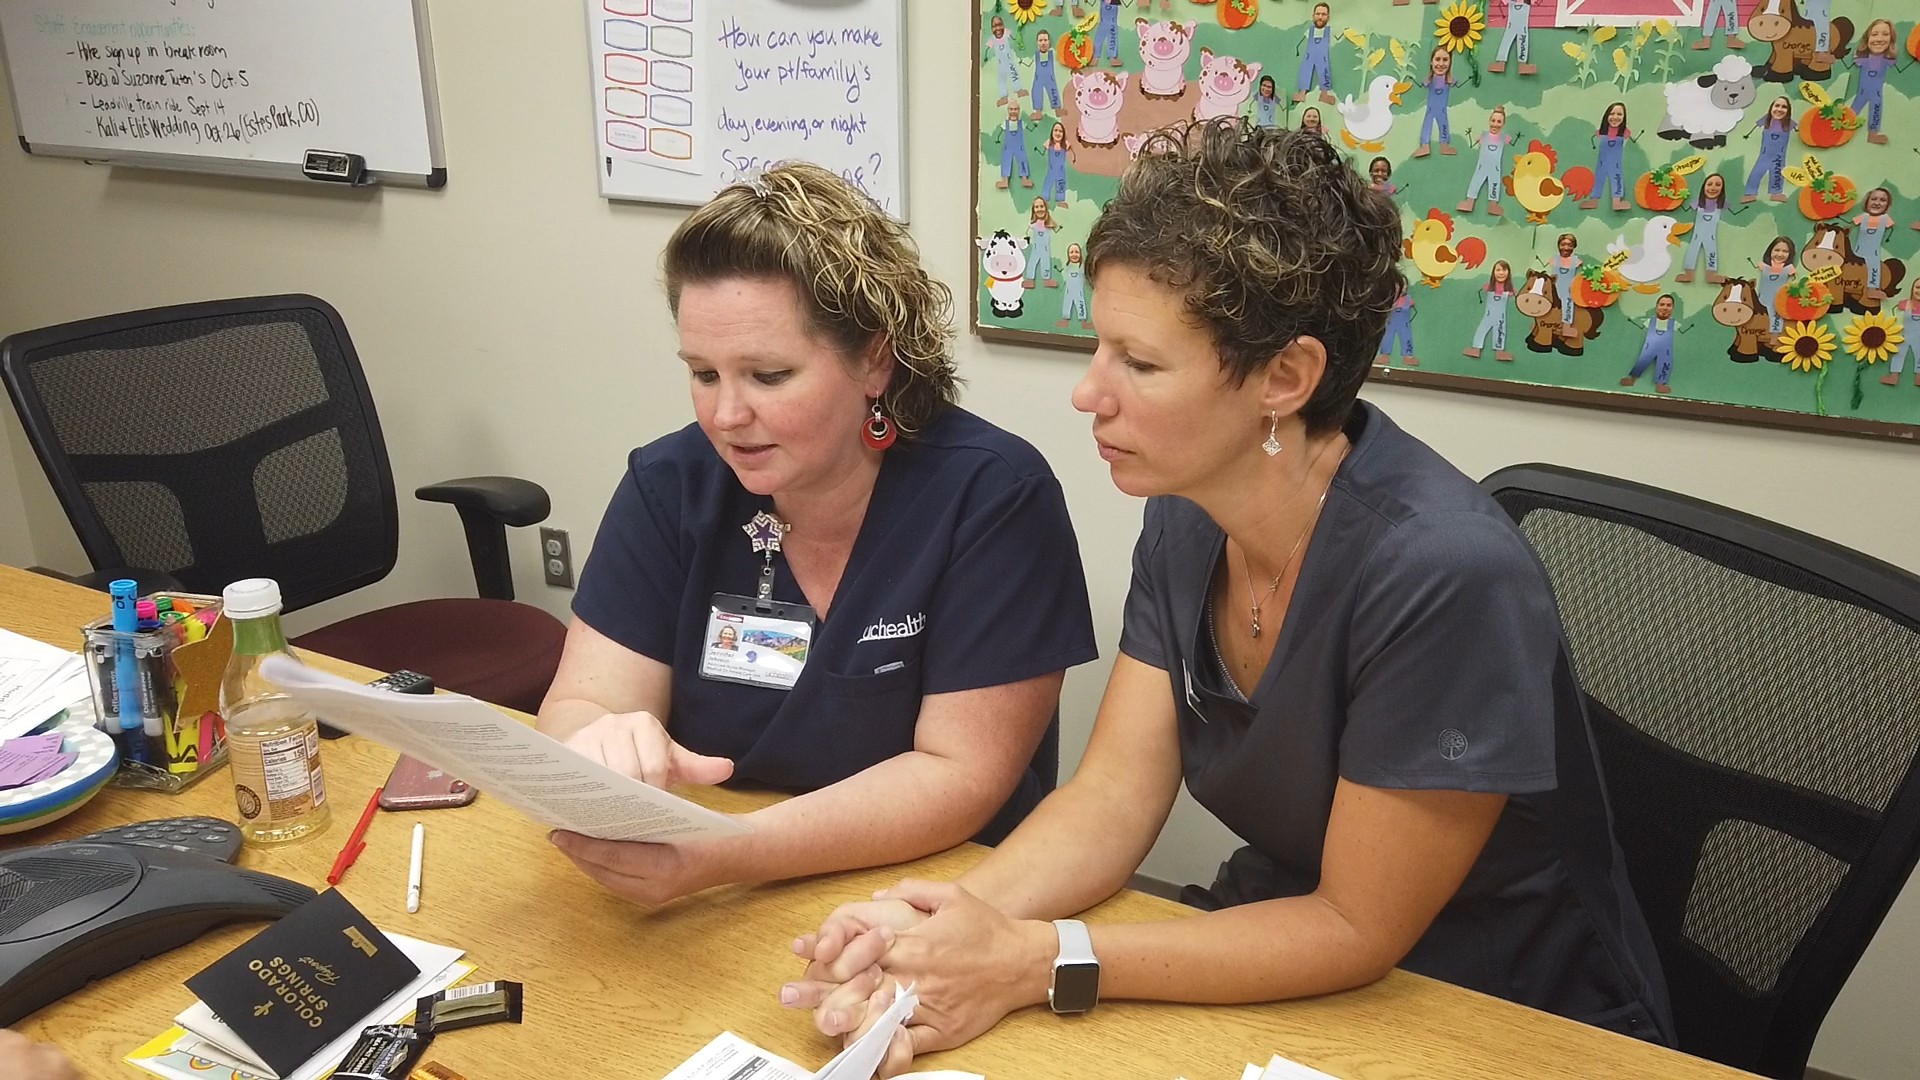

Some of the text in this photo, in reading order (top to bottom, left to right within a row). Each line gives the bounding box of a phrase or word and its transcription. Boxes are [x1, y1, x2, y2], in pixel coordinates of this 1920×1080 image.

[718, 15, 882, 58] How can you make
[1782, 40, 1812, 55] Charge
[147, 46, 158, 57] in
[86, 70, 109, 87] BBQ
[238, 70, 250, 87] 5
[136, 93, 160, 109] train
[164, 98, 182, 112] ride
[187, 96, 211, 117] Sept
[214, 99, 225, 115] 14
[149, 115, 200, 144] Wedding
[831, 111, 867, 145] night
[1835, 276, 1863, 290] Charge
[860, 611, 926, 642] uchealth
[264, 756, 287, 765] Calories
[248, 959, 323, 1028] COLORADO
[269, 956, 329, 1011] SPRINGS
